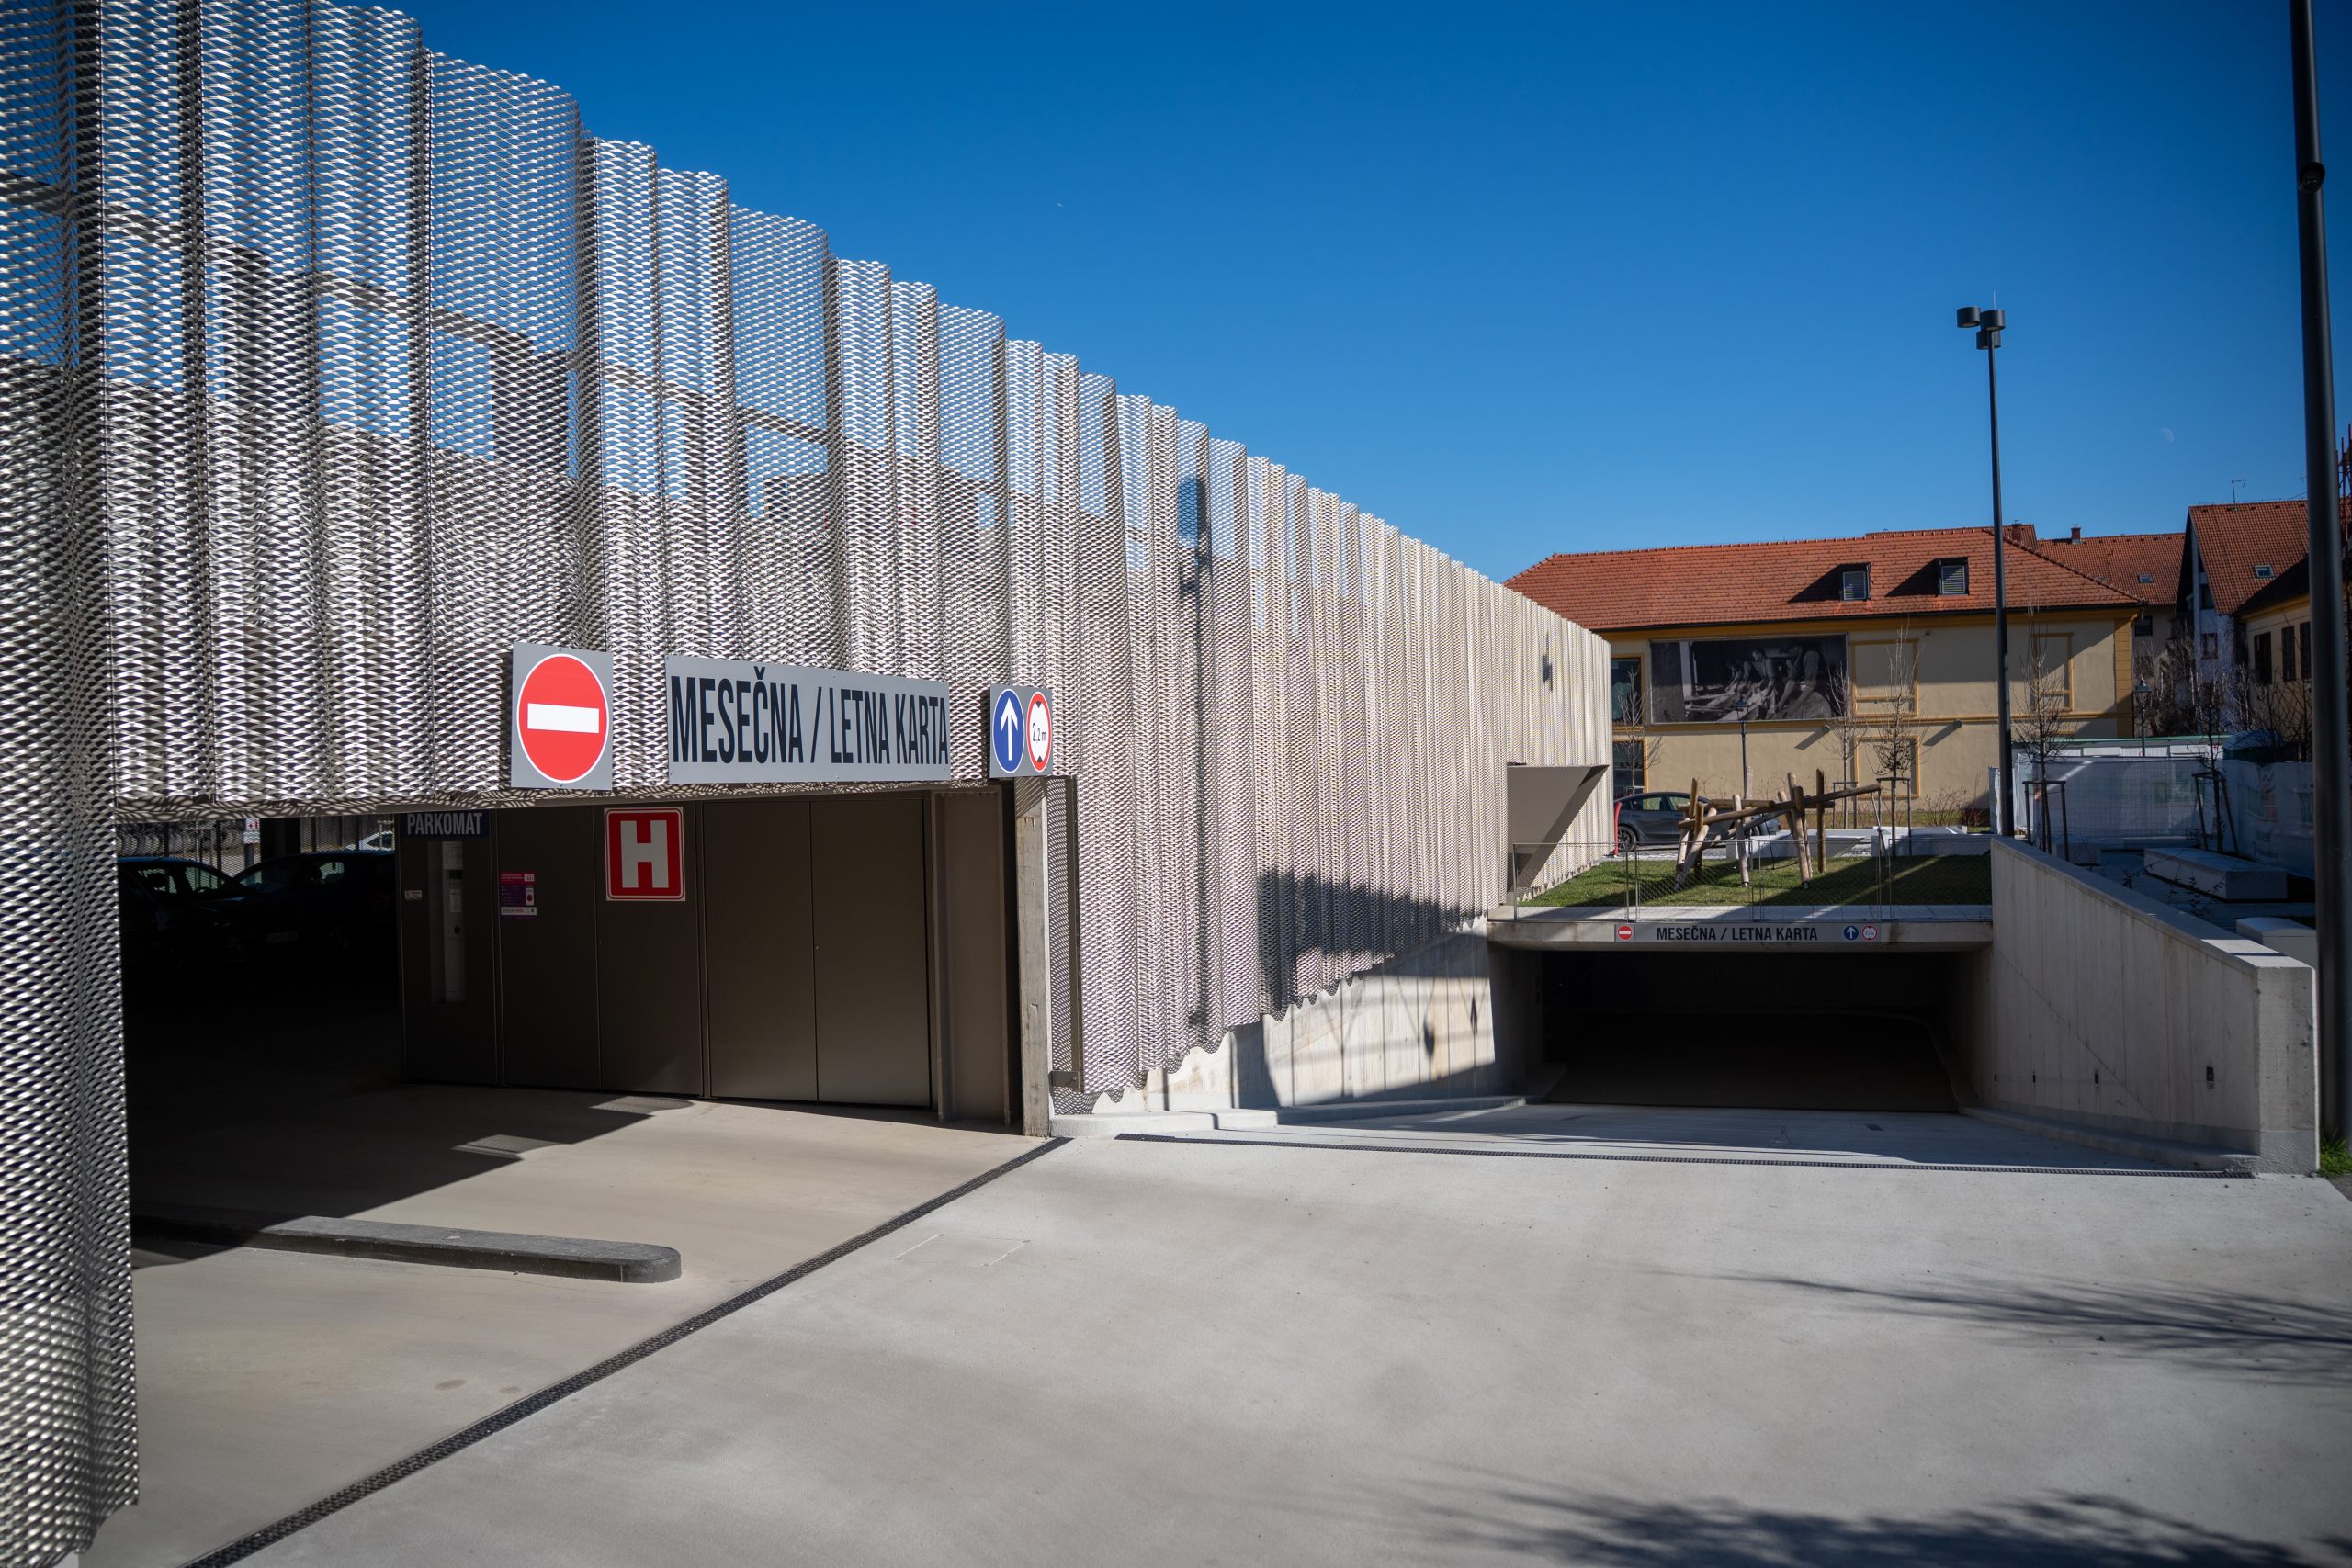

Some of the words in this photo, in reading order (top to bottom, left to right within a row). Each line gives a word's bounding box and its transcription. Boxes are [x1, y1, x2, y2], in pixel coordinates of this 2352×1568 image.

[671, 666, 804, 763] MESEČNA
[810, 687, 822, 763] /
[829, 688, 890, 764] LETNA
[895, 694, 949, 765] KARTA
[407, 812, 482, 835] PARKOMAT
[620, 820, 669, 888] H
[1657, 925, 1716, 941] MESEČNA
[1720, 928, 1727, 941] /
[1732, 928, 1772, 941] LETNA
[1777, 928, 1818, 941] KARTA
